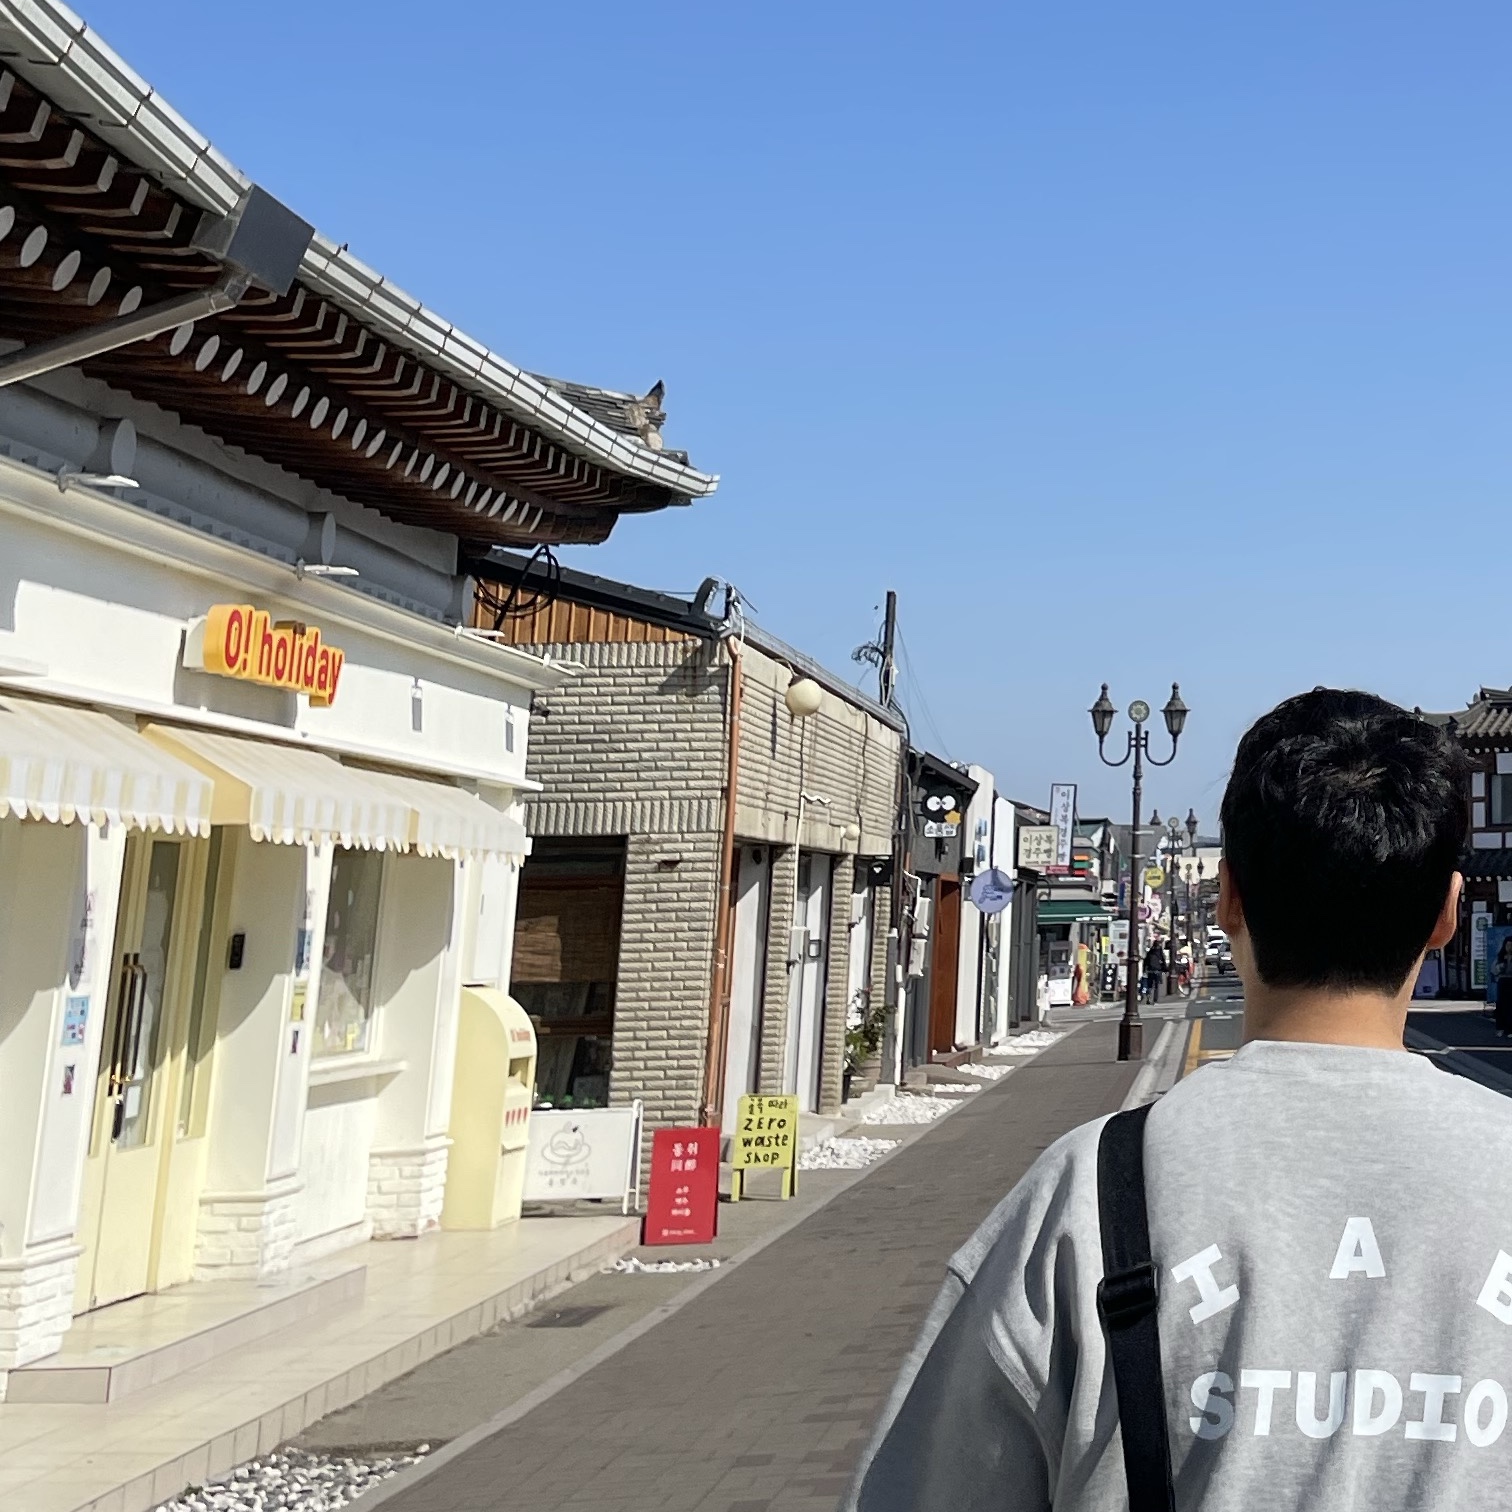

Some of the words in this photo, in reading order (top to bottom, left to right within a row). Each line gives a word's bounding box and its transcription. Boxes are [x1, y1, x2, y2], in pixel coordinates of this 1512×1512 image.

[258, 615, 343, 705] holiday
[742, 1133, 789, 1148] waste
[1189, 1368, 1509, 1448] STUDIO
